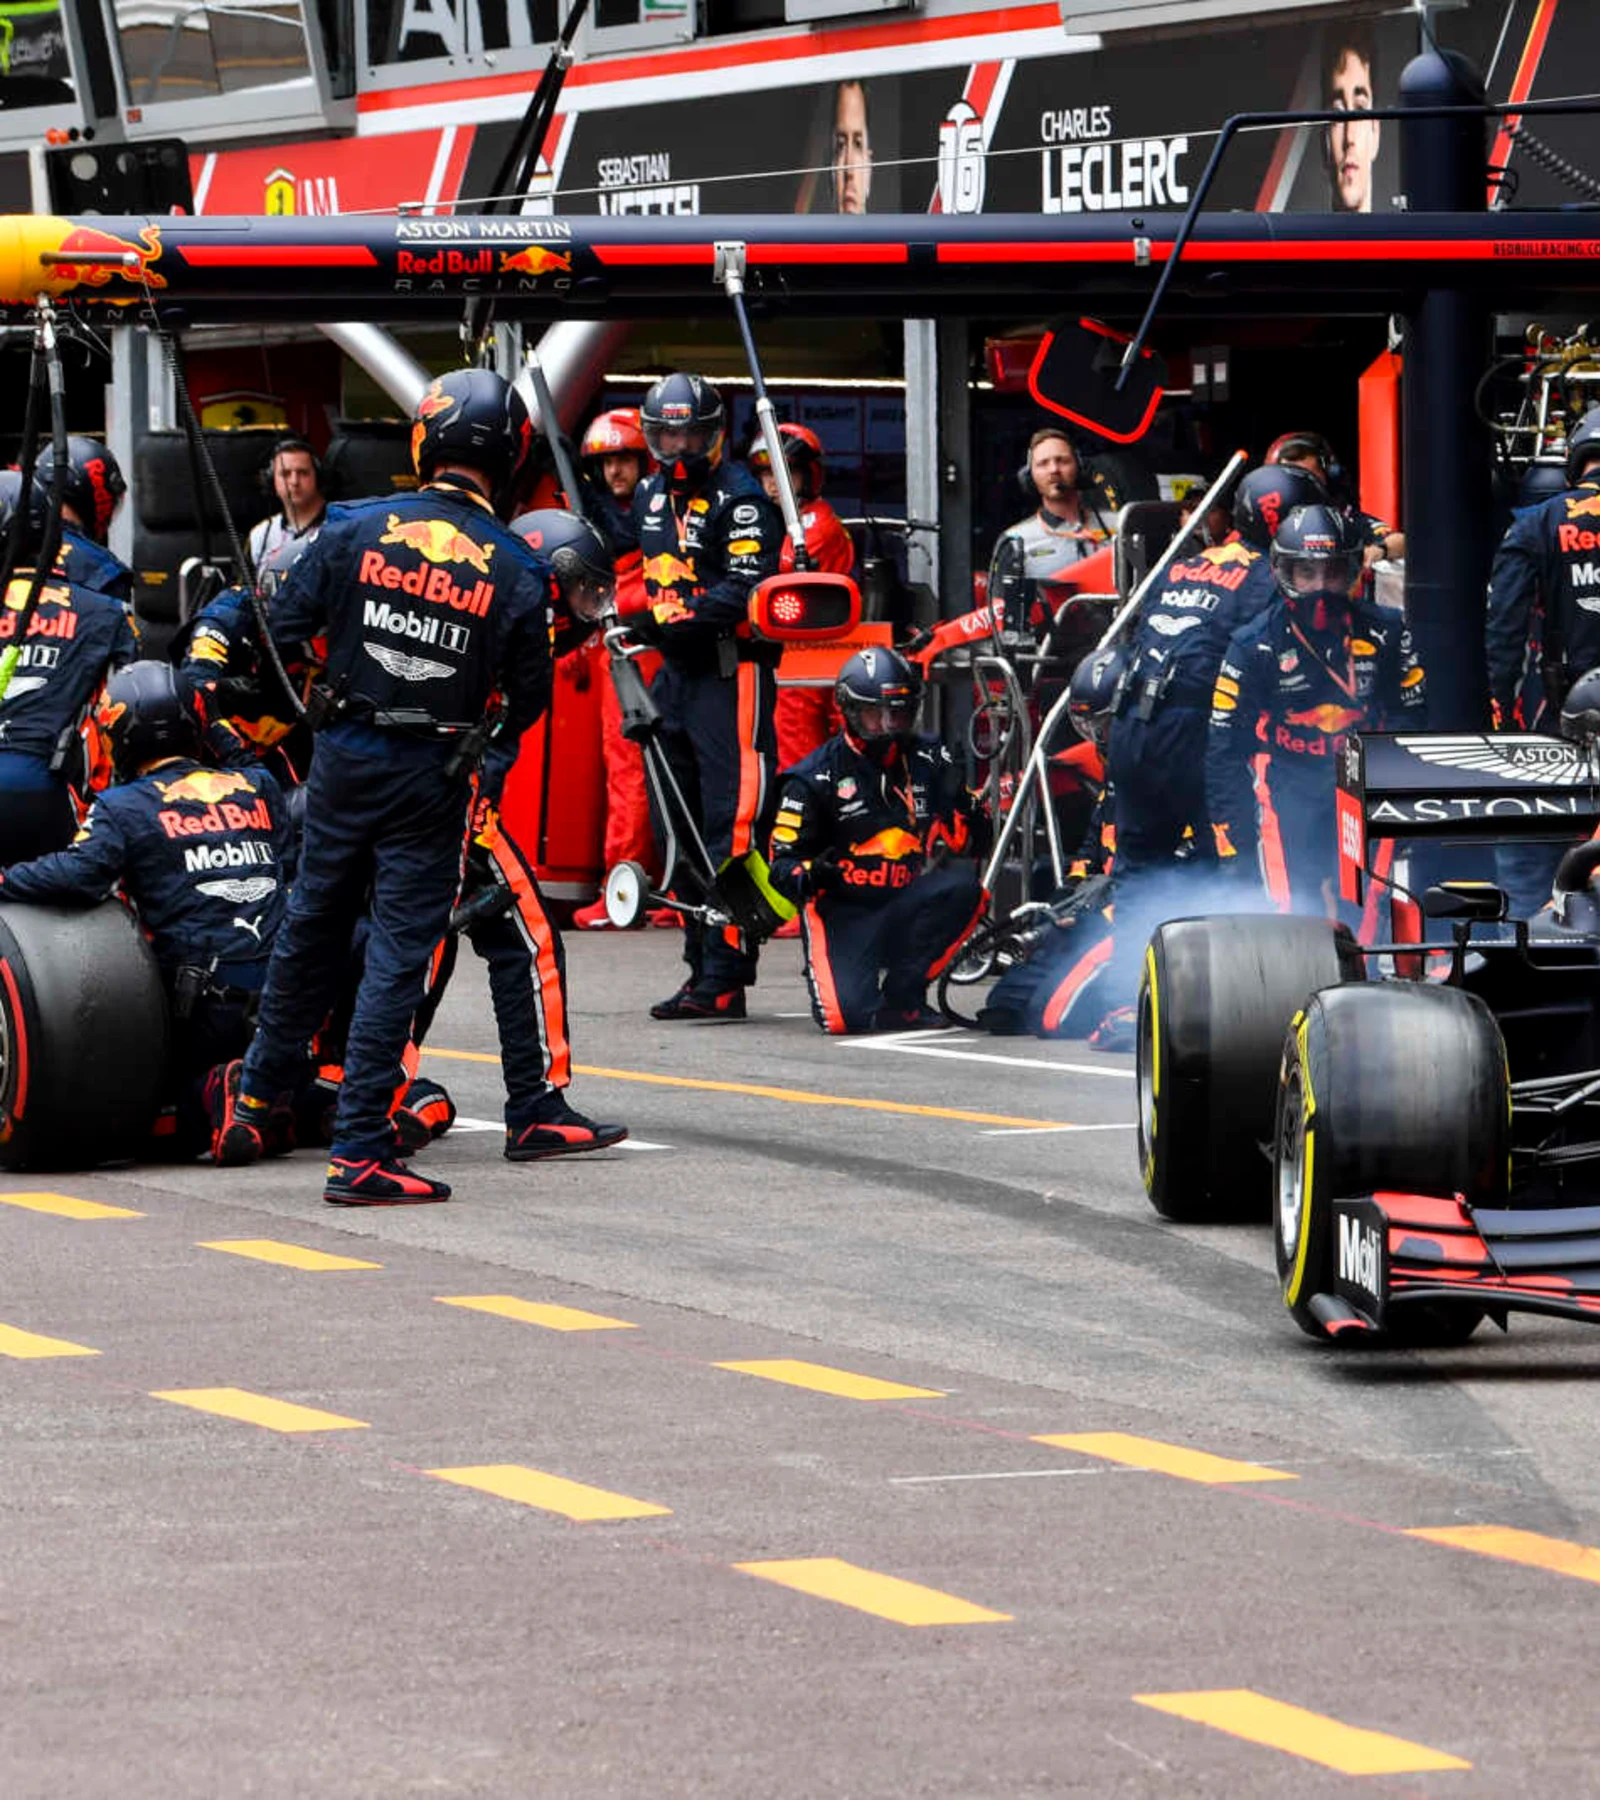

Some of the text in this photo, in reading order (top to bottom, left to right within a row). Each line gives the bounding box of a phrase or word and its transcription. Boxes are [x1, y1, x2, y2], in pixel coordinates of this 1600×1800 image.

[1041, 106, 1111, 142] CHARLES
[598, 153, 671, 187] SEBASTIAN
[938, 117, 986, 214] 16
[1043, 136, 1189, 214] LECLERC
[396, 221, 572, 238] ASTON MARTIN
[397, 249, 493, 274] Red Bull
[394, 278, 572, 292] RACING
[359, 550, 496, 618] Red Bull
[363, 600, 439, 644] Mobil
[1513, 748, 1577, 763] ASTON
[158, 797, 273, 839] Red Bull
[1371, 797, 1578, 822] ASTON
[184, 841, 258, 873] Mobil
[1339, 1214, 1377, 1295] Mobil
